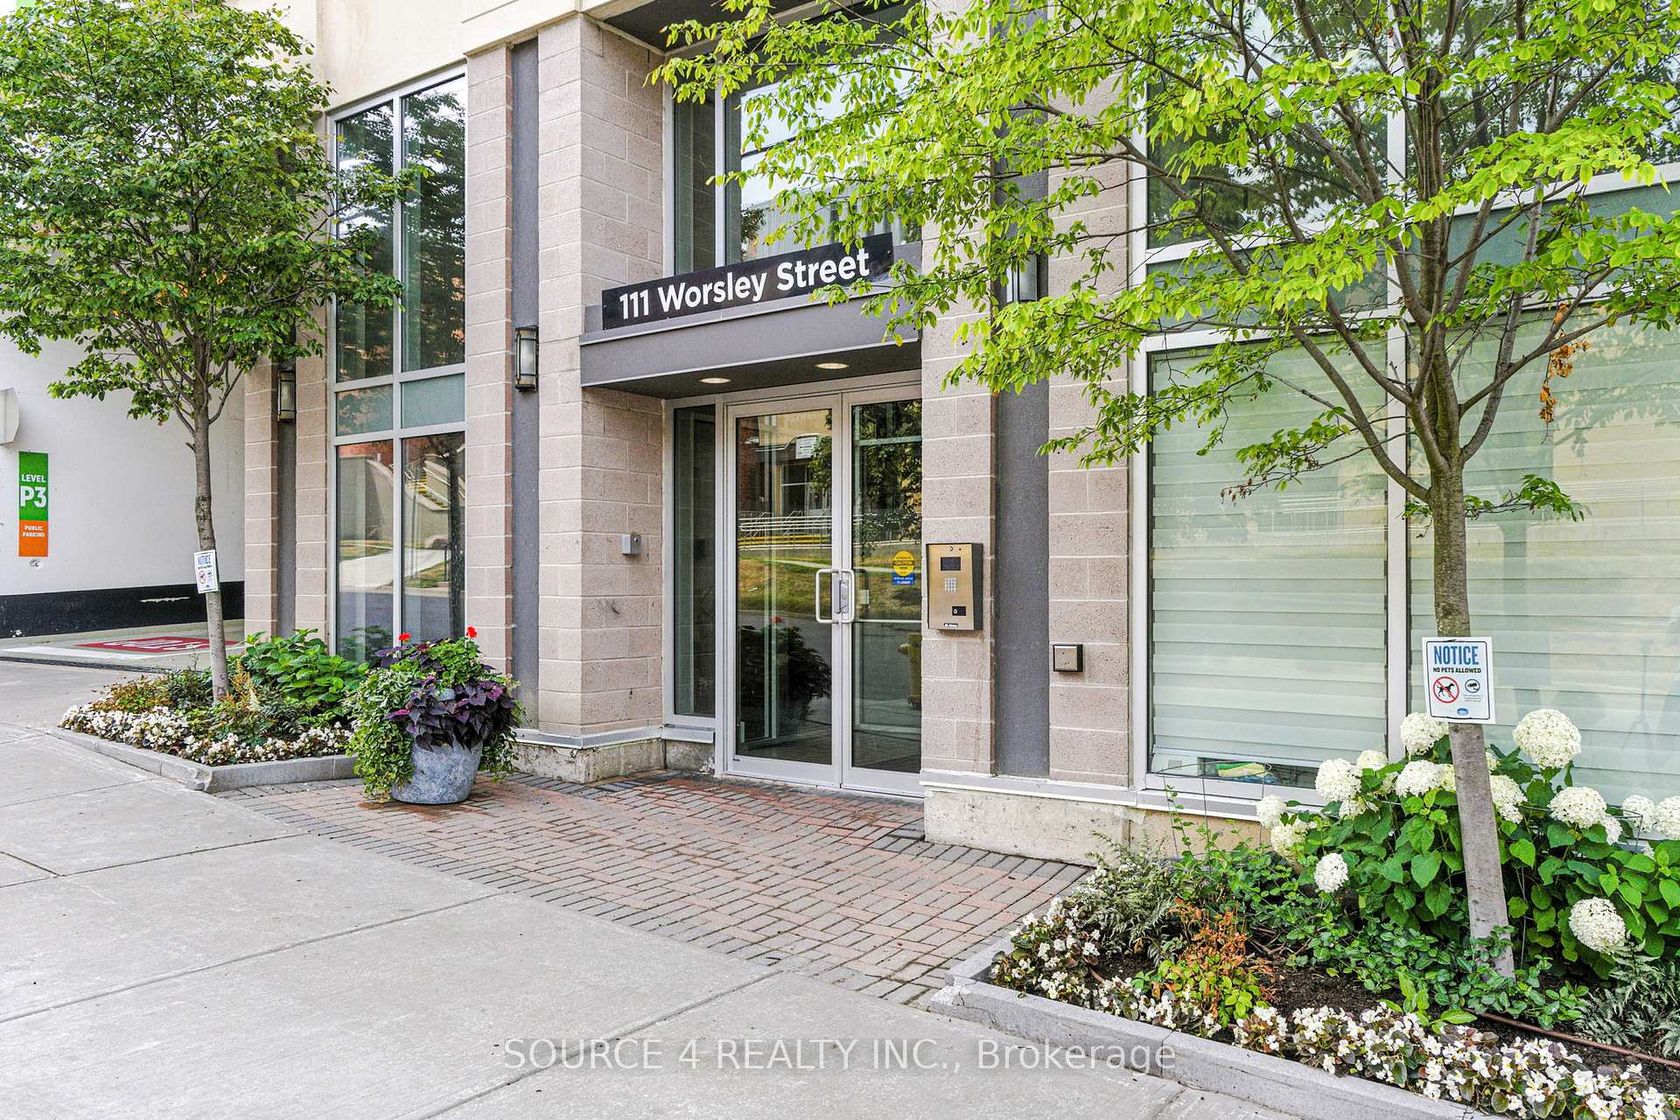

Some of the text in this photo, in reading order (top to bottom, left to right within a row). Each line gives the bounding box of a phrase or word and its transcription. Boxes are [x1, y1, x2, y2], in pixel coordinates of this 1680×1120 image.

[619, 248, 871, 320] 111 Worsley Street
[21, 474, 47, 483] LEVEL
[20, 485, 47, 508] P3
[1433, 645, 1480, 665] NOTICE
